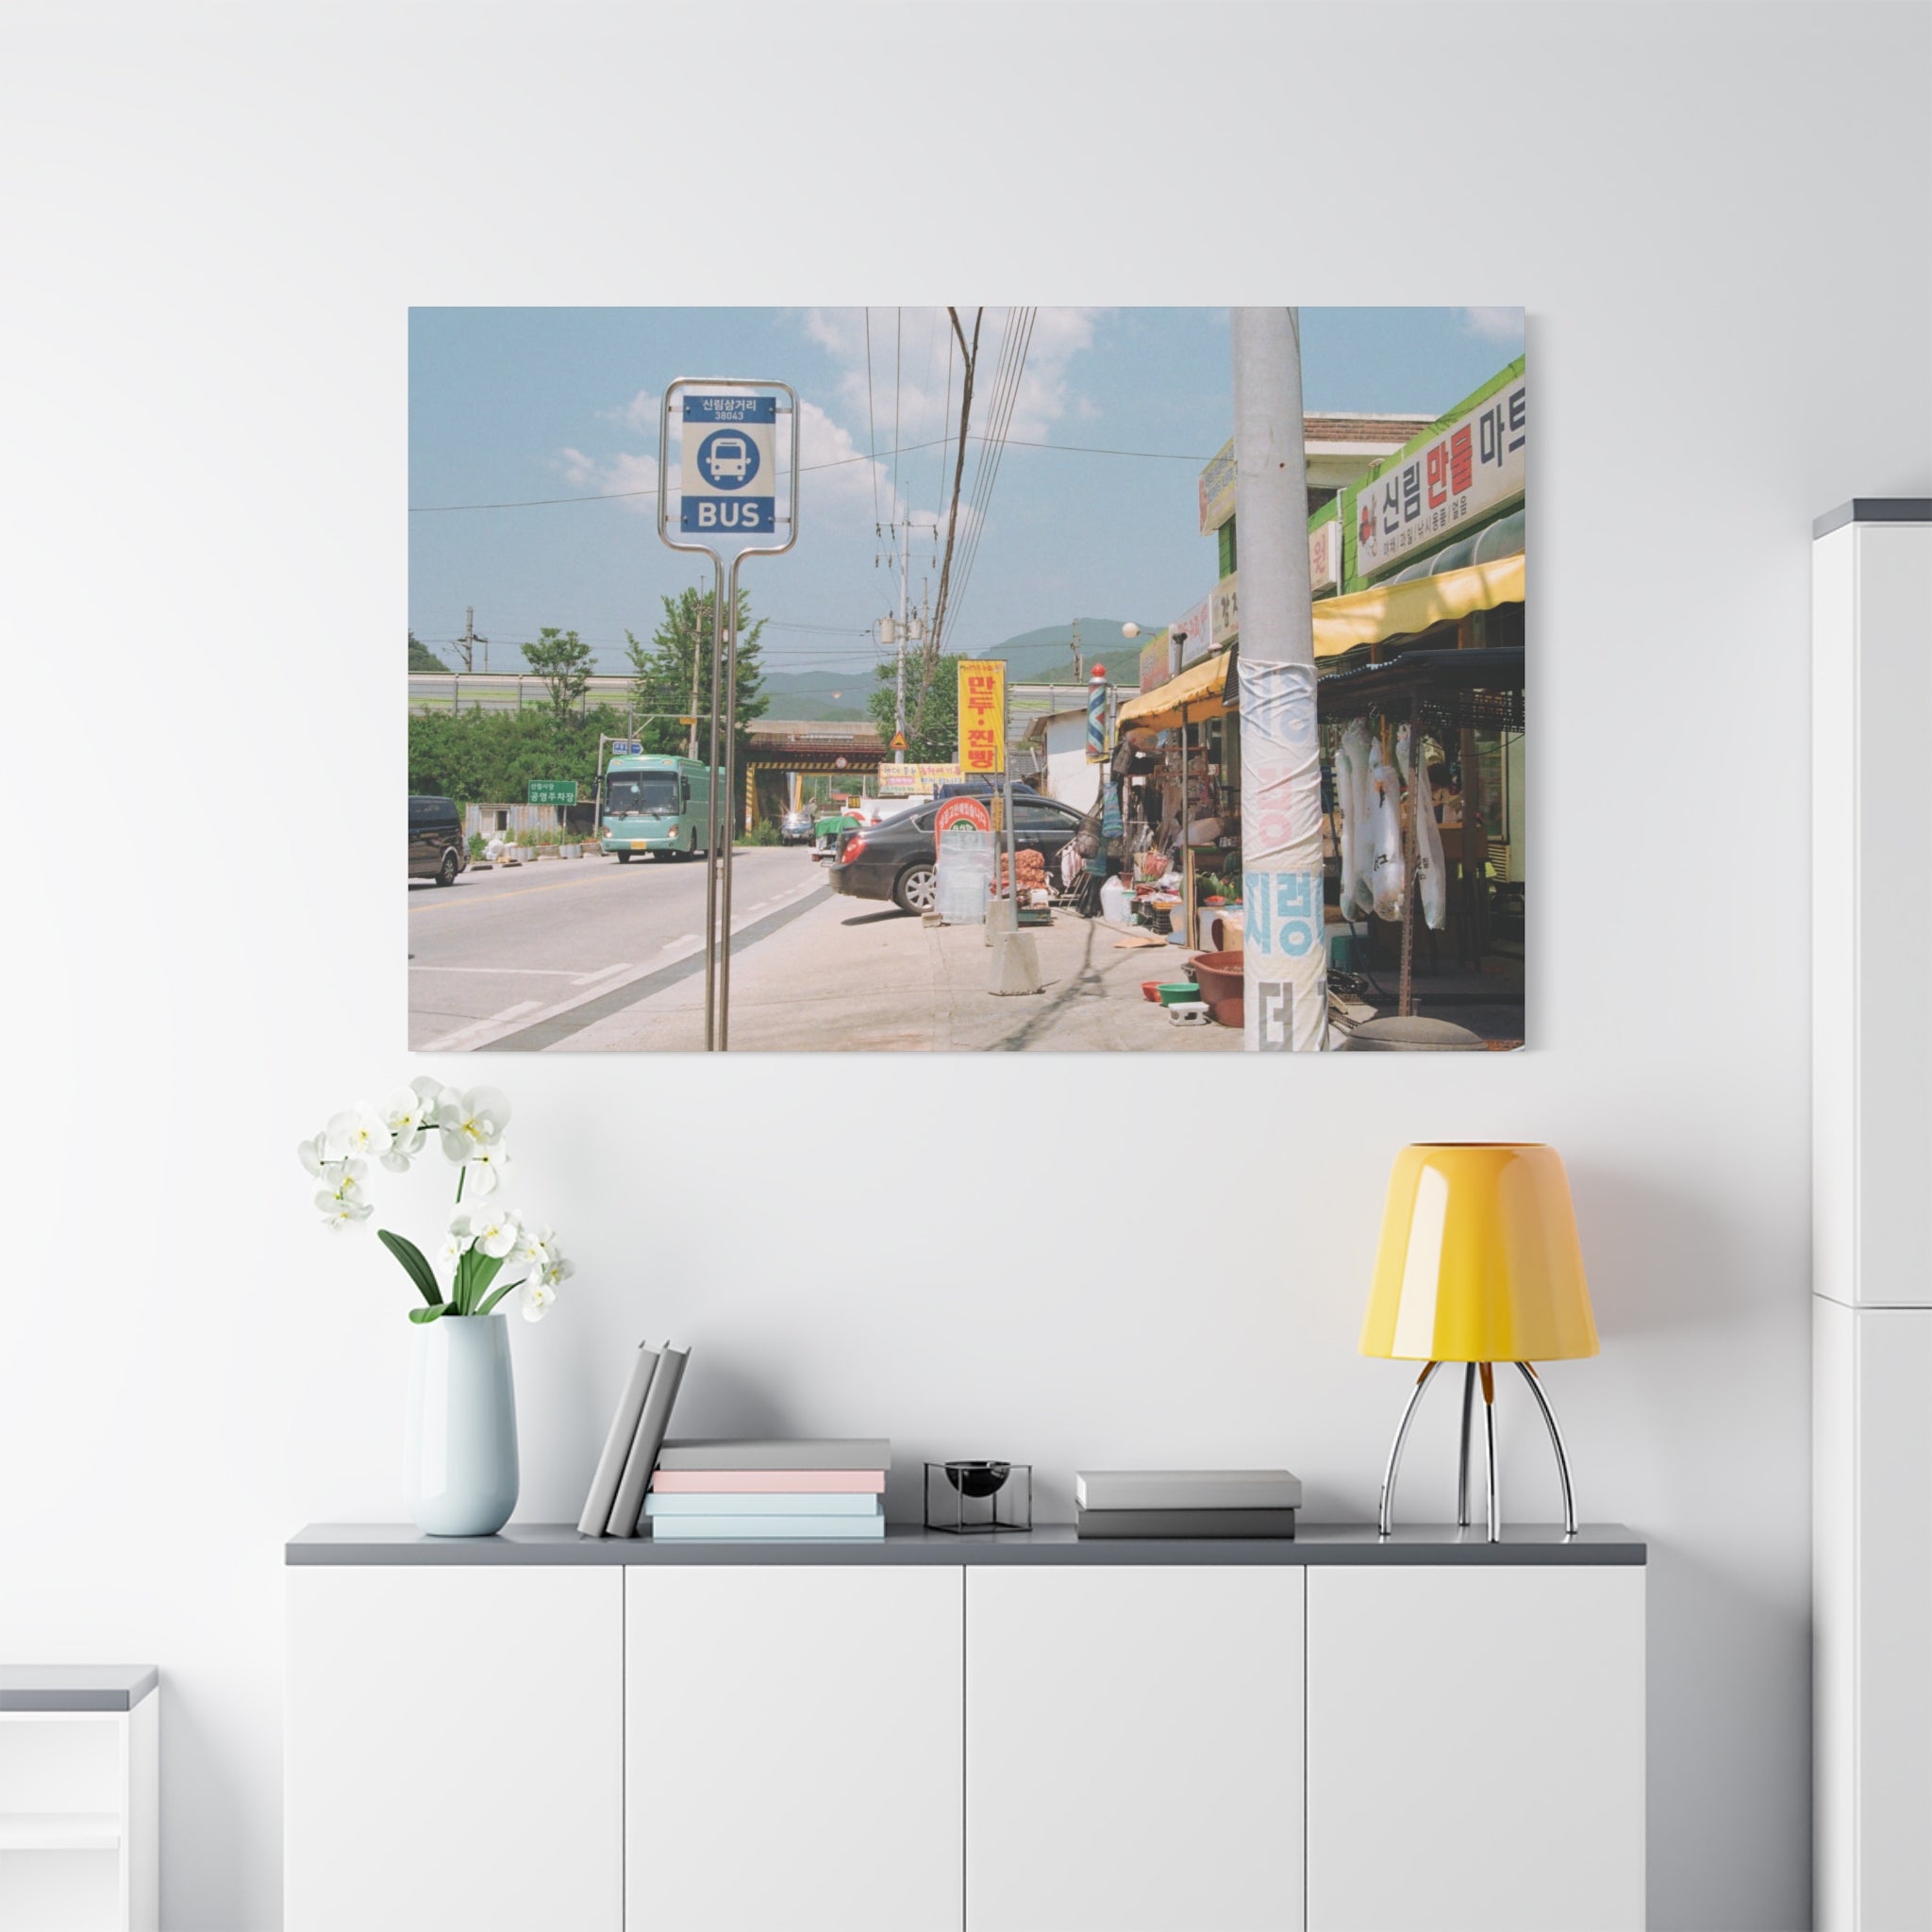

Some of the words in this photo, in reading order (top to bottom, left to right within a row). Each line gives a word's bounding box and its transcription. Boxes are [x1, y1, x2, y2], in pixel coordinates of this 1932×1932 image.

[703, 399, 757, 411] 신림삼거리
[715, 411, 744, 421] 38043
[1383, 460, 1421, 535] 신림
[1426, 423, 1473, 509] 만물
[698, 502, 759, 527] BUS
